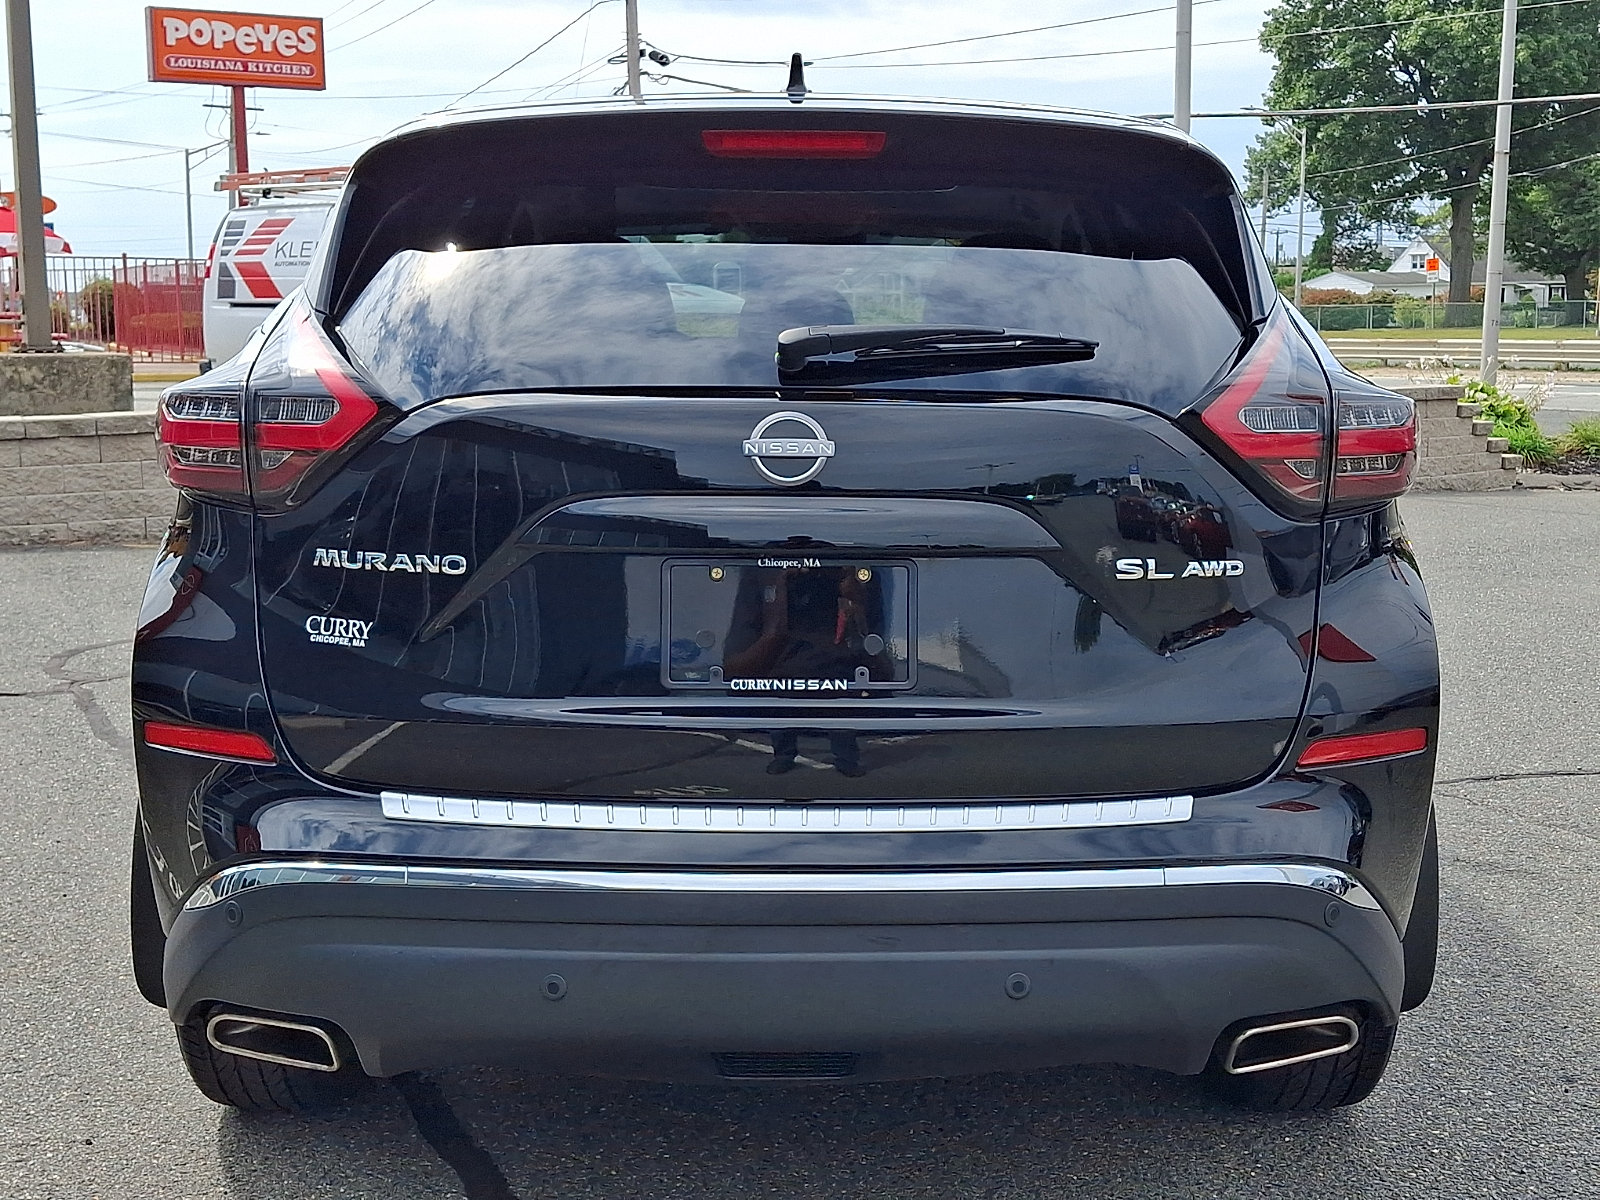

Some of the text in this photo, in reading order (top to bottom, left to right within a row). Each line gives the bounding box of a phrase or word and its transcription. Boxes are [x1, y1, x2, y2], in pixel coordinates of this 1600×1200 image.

[169, 57, 311, 75] LOUISIANA KITCHEN
[744, 442, 833, 455] NISSAN
[312, 548, 467, 575] MURANO
[757, 558, 821, 569] Chicopee, MA
[1115, 558, 1245, 580] SL AWD
[305, 615, 374, 640] CURRY
[309, 634, 366, 648] CHICOPEE, MA
